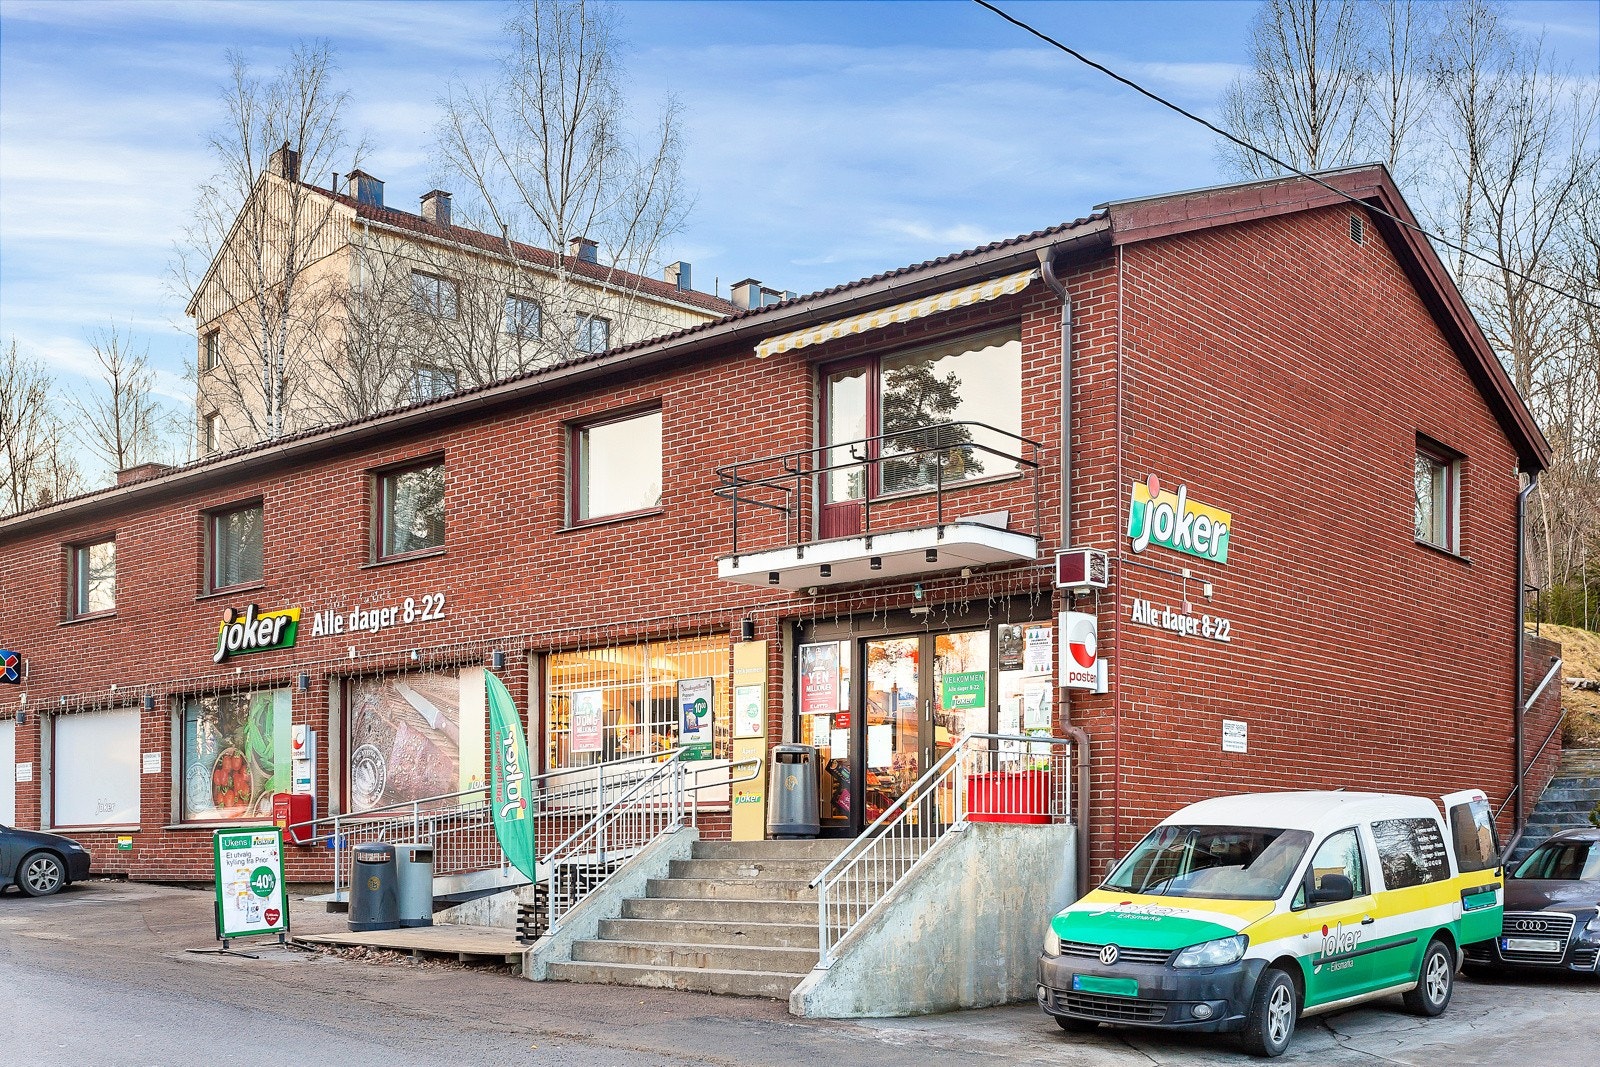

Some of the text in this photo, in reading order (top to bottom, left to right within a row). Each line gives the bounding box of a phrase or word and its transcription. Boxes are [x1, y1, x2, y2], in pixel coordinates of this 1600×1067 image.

[1132, 473, 1227, 557] joker
[311, 592, 445, 637] Alle dager 8-22
[1131, 598, 1231, 642] Alle dager 8-22
[213, 604, 290, 663] joker
[944, 674, 984, 684] VELKOMMEN
[736, 791, 760, 805] joker
[224, 839, 248, 847] Ukens
[226, 859, 245, 867] kylling
[252, 874, 274, 889] -40%
[1313, 920, 1362, 976] joker
